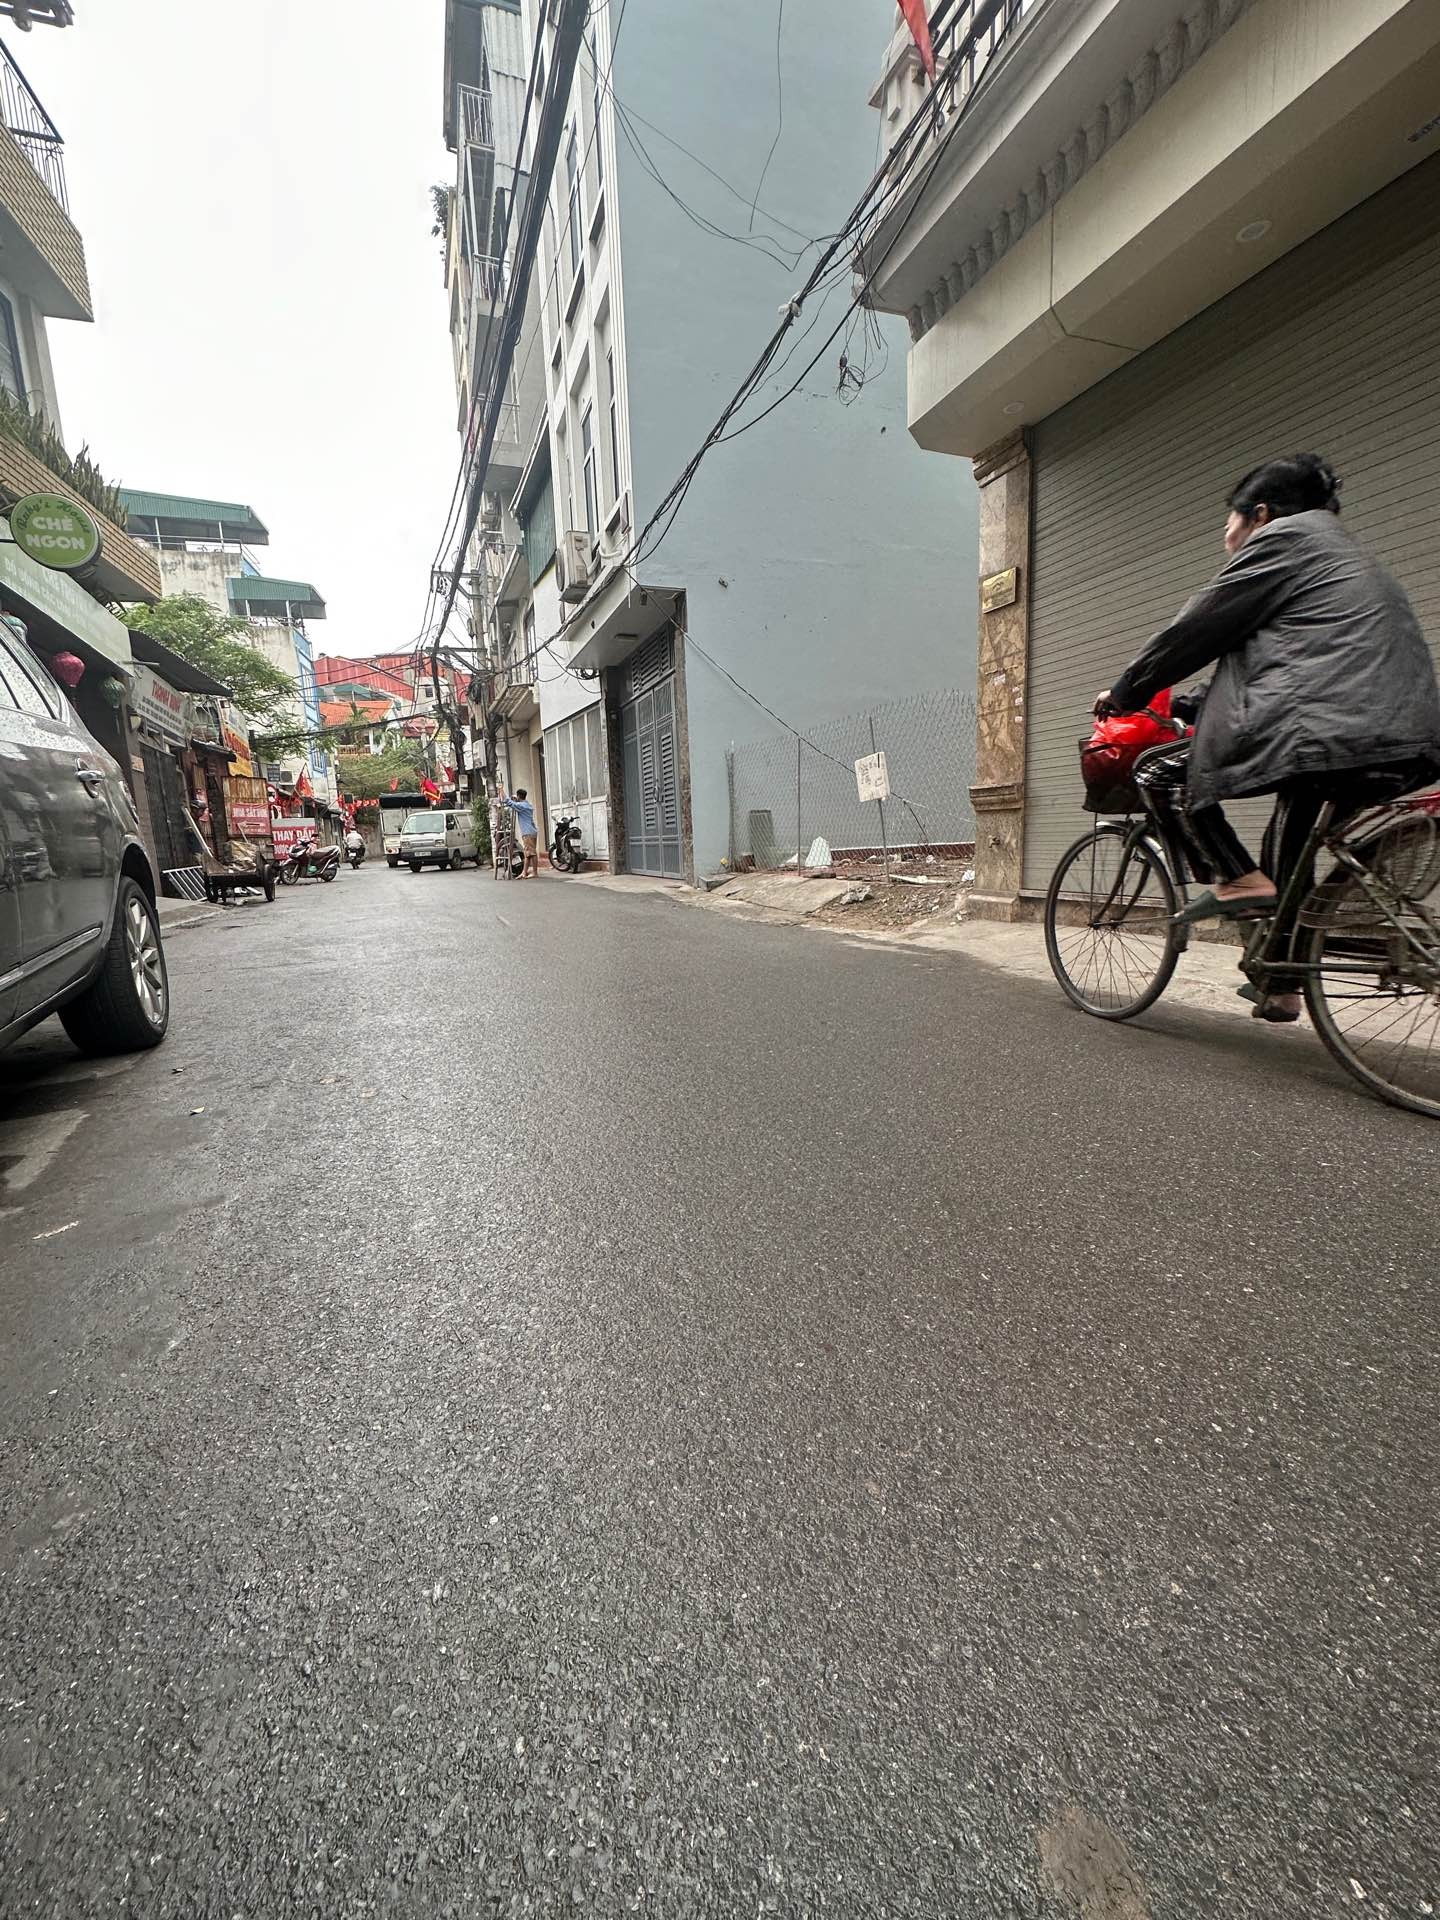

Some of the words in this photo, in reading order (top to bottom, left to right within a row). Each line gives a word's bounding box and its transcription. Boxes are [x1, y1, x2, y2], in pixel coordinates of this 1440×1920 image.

[32, 515, 74, 531] CHÈ
[25, 534, 85, 550] NGON
[272, 830, 294, 841] THAY
